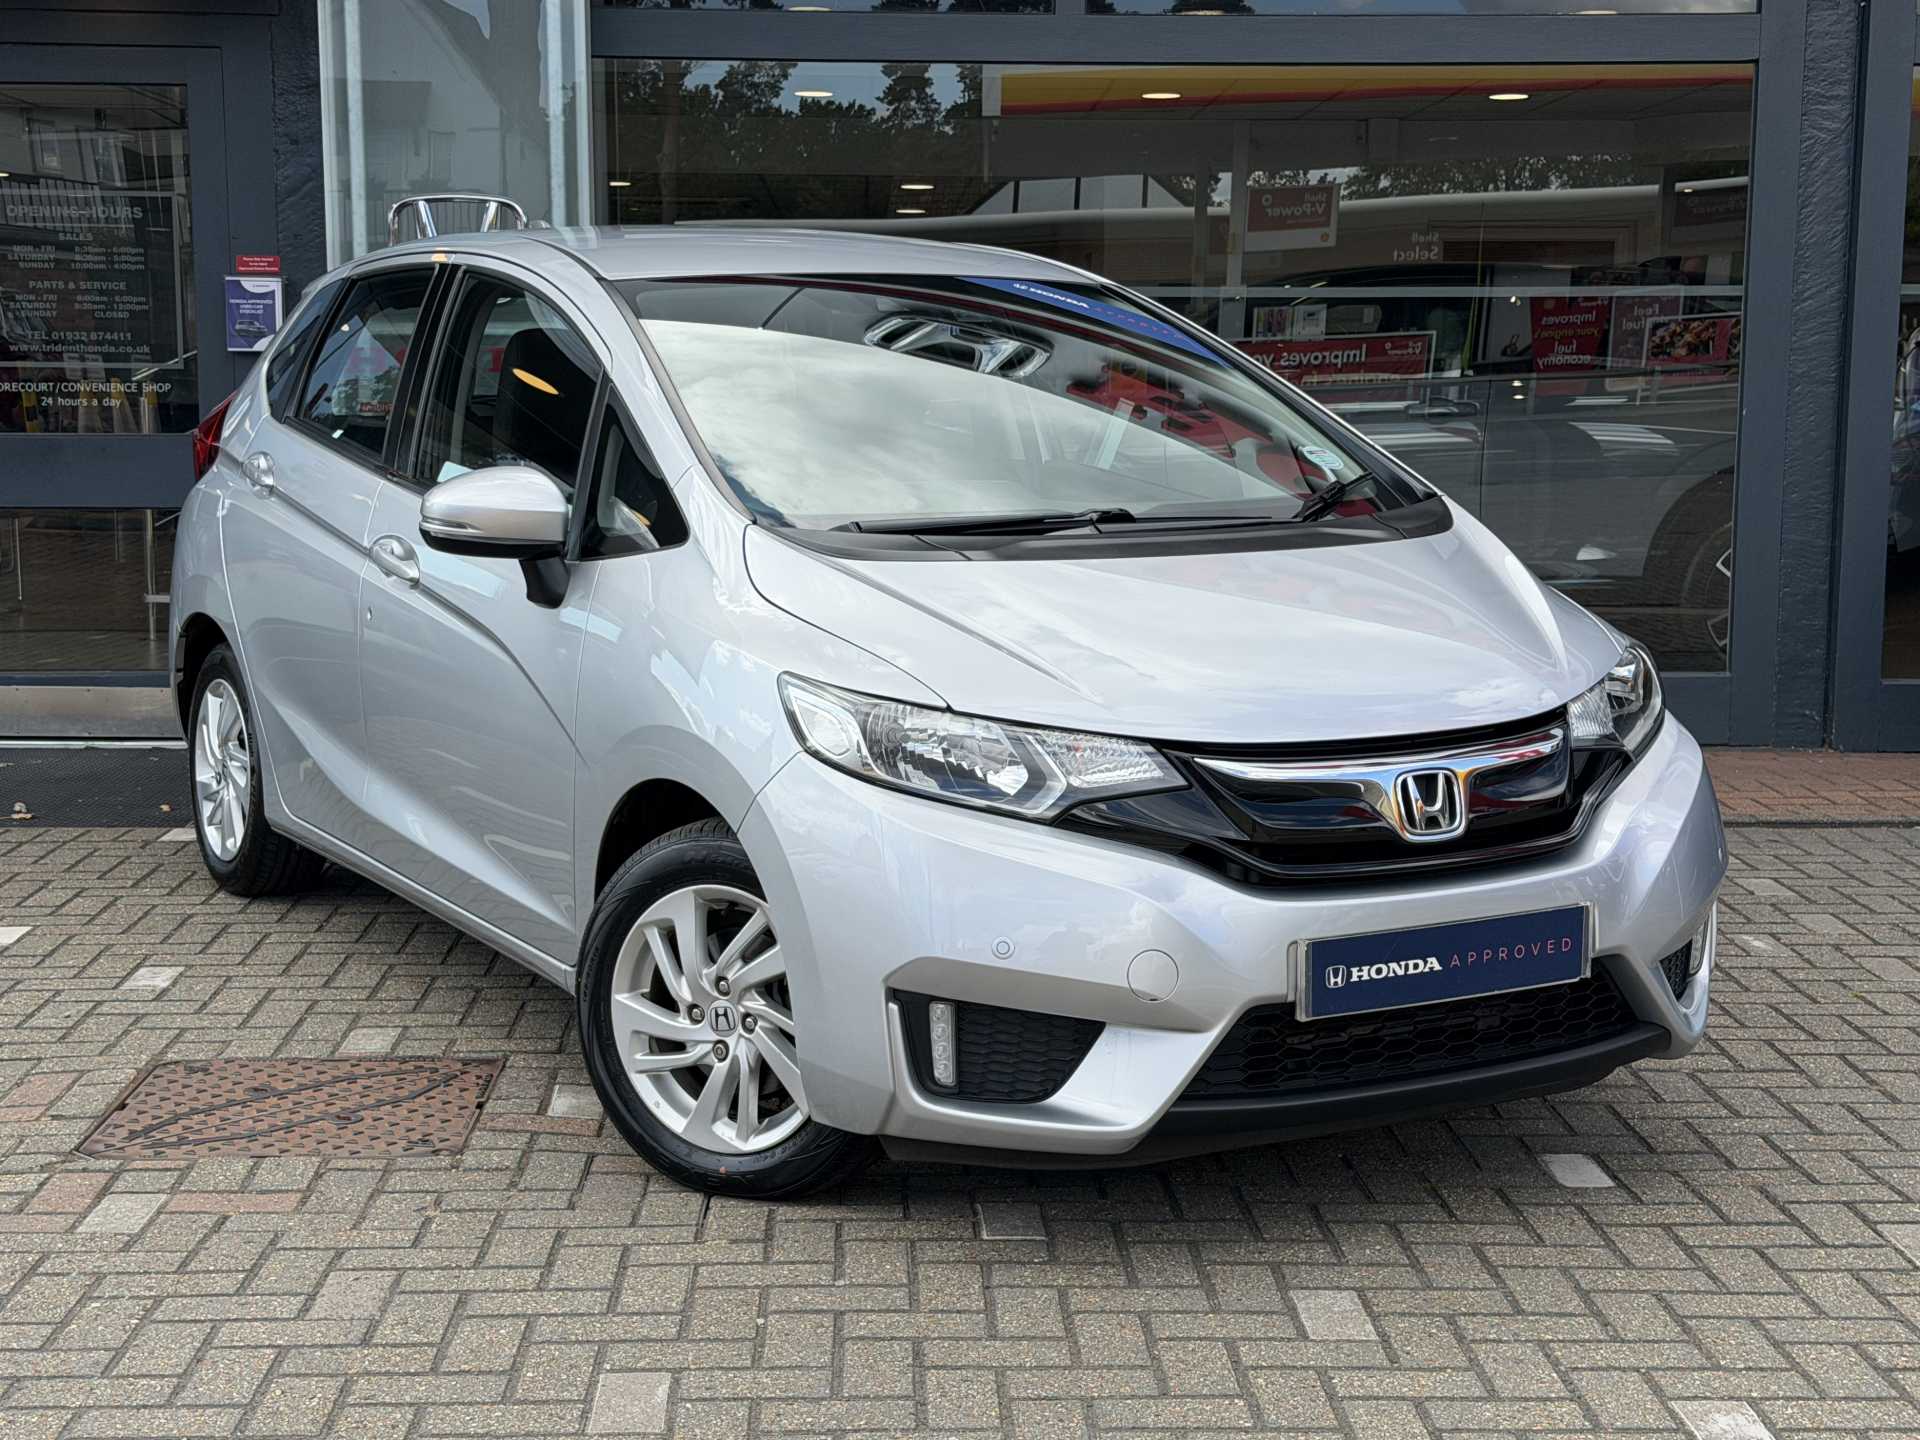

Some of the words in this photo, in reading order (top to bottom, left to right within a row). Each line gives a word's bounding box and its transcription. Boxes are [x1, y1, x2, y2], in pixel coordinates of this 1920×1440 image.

[58, 233, 93, 241] SALES
[28, 281, 64, 289] PARTS
[79, 281, 127, 290] SERVICE
[94, 311, 130, 319] CLOSED
[142, 383, 172, 392] SHOP
[40, 397, 53, 406] 24
[57, 396, 88, 406] hours
[102, 396, 121, 408] day
[1350, 956, 1443, 983] HONDA
[1449, 937, 1574, 969] APPROVED
